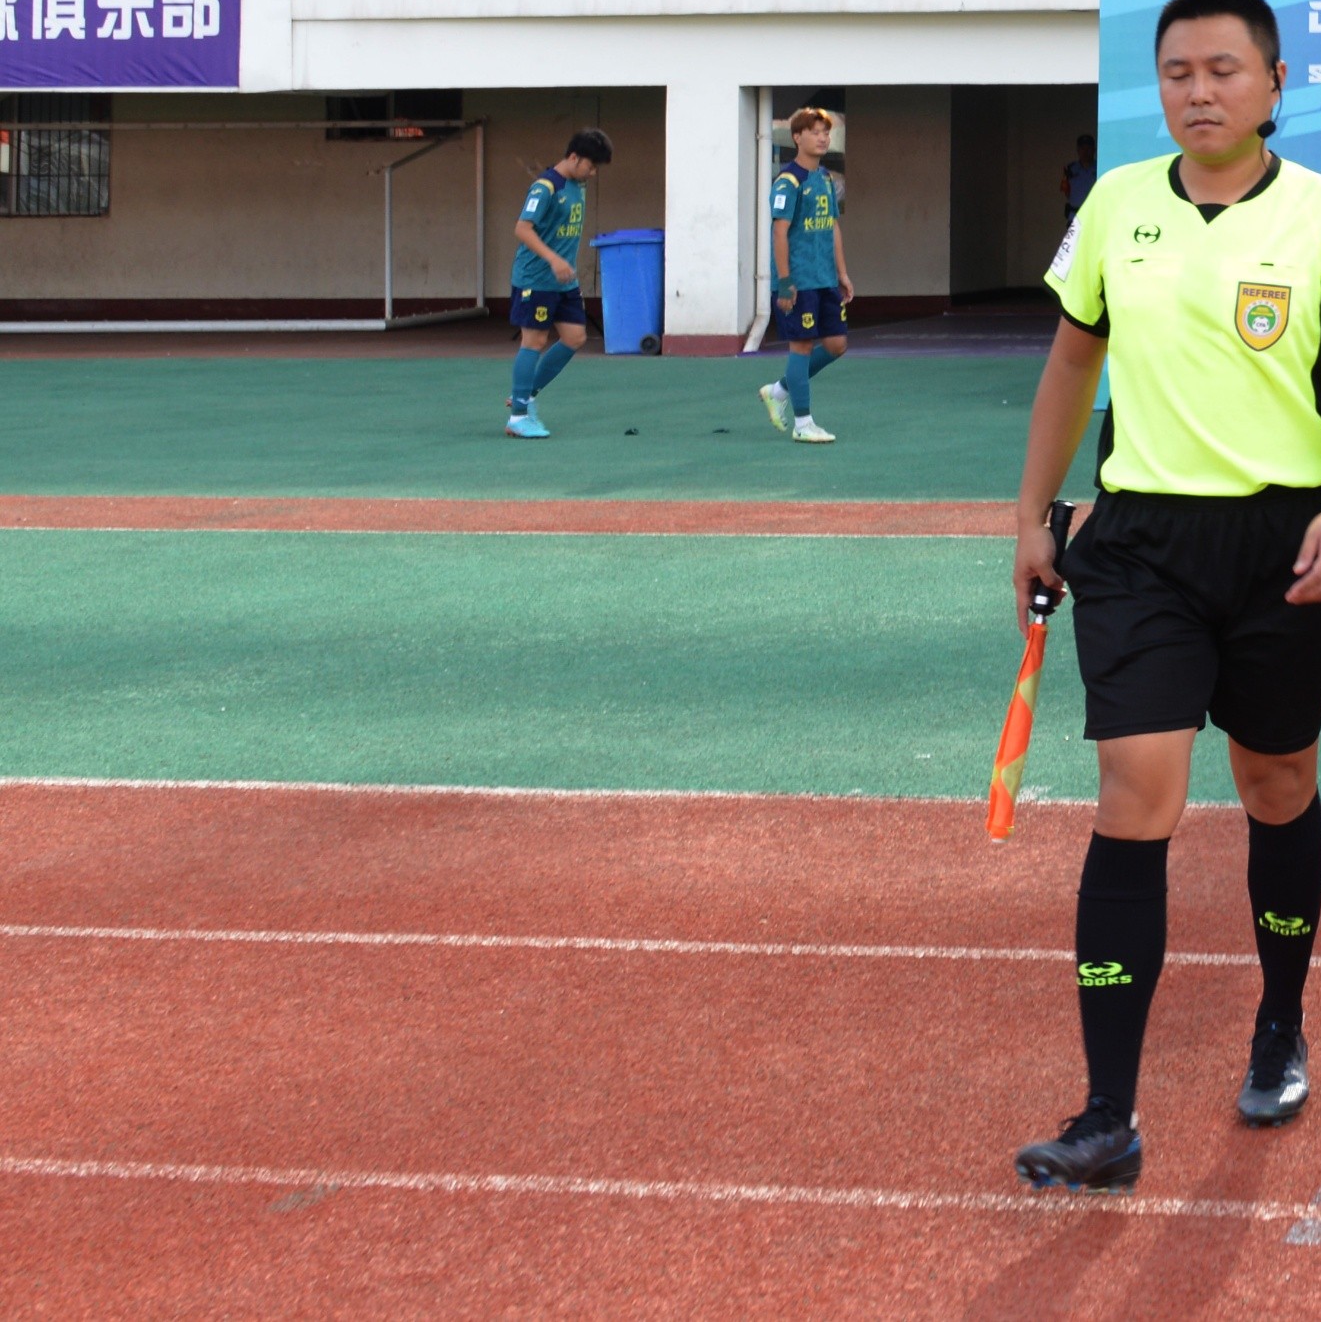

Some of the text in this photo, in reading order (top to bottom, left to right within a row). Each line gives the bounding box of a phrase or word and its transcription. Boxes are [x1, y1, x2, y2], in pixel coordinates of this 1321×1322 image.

[1242, 286, 1287, 300] REFEREE
[1258, 918, 1311, 937] LOOKS
[1076, 975, 1132, 987] LOOKS
